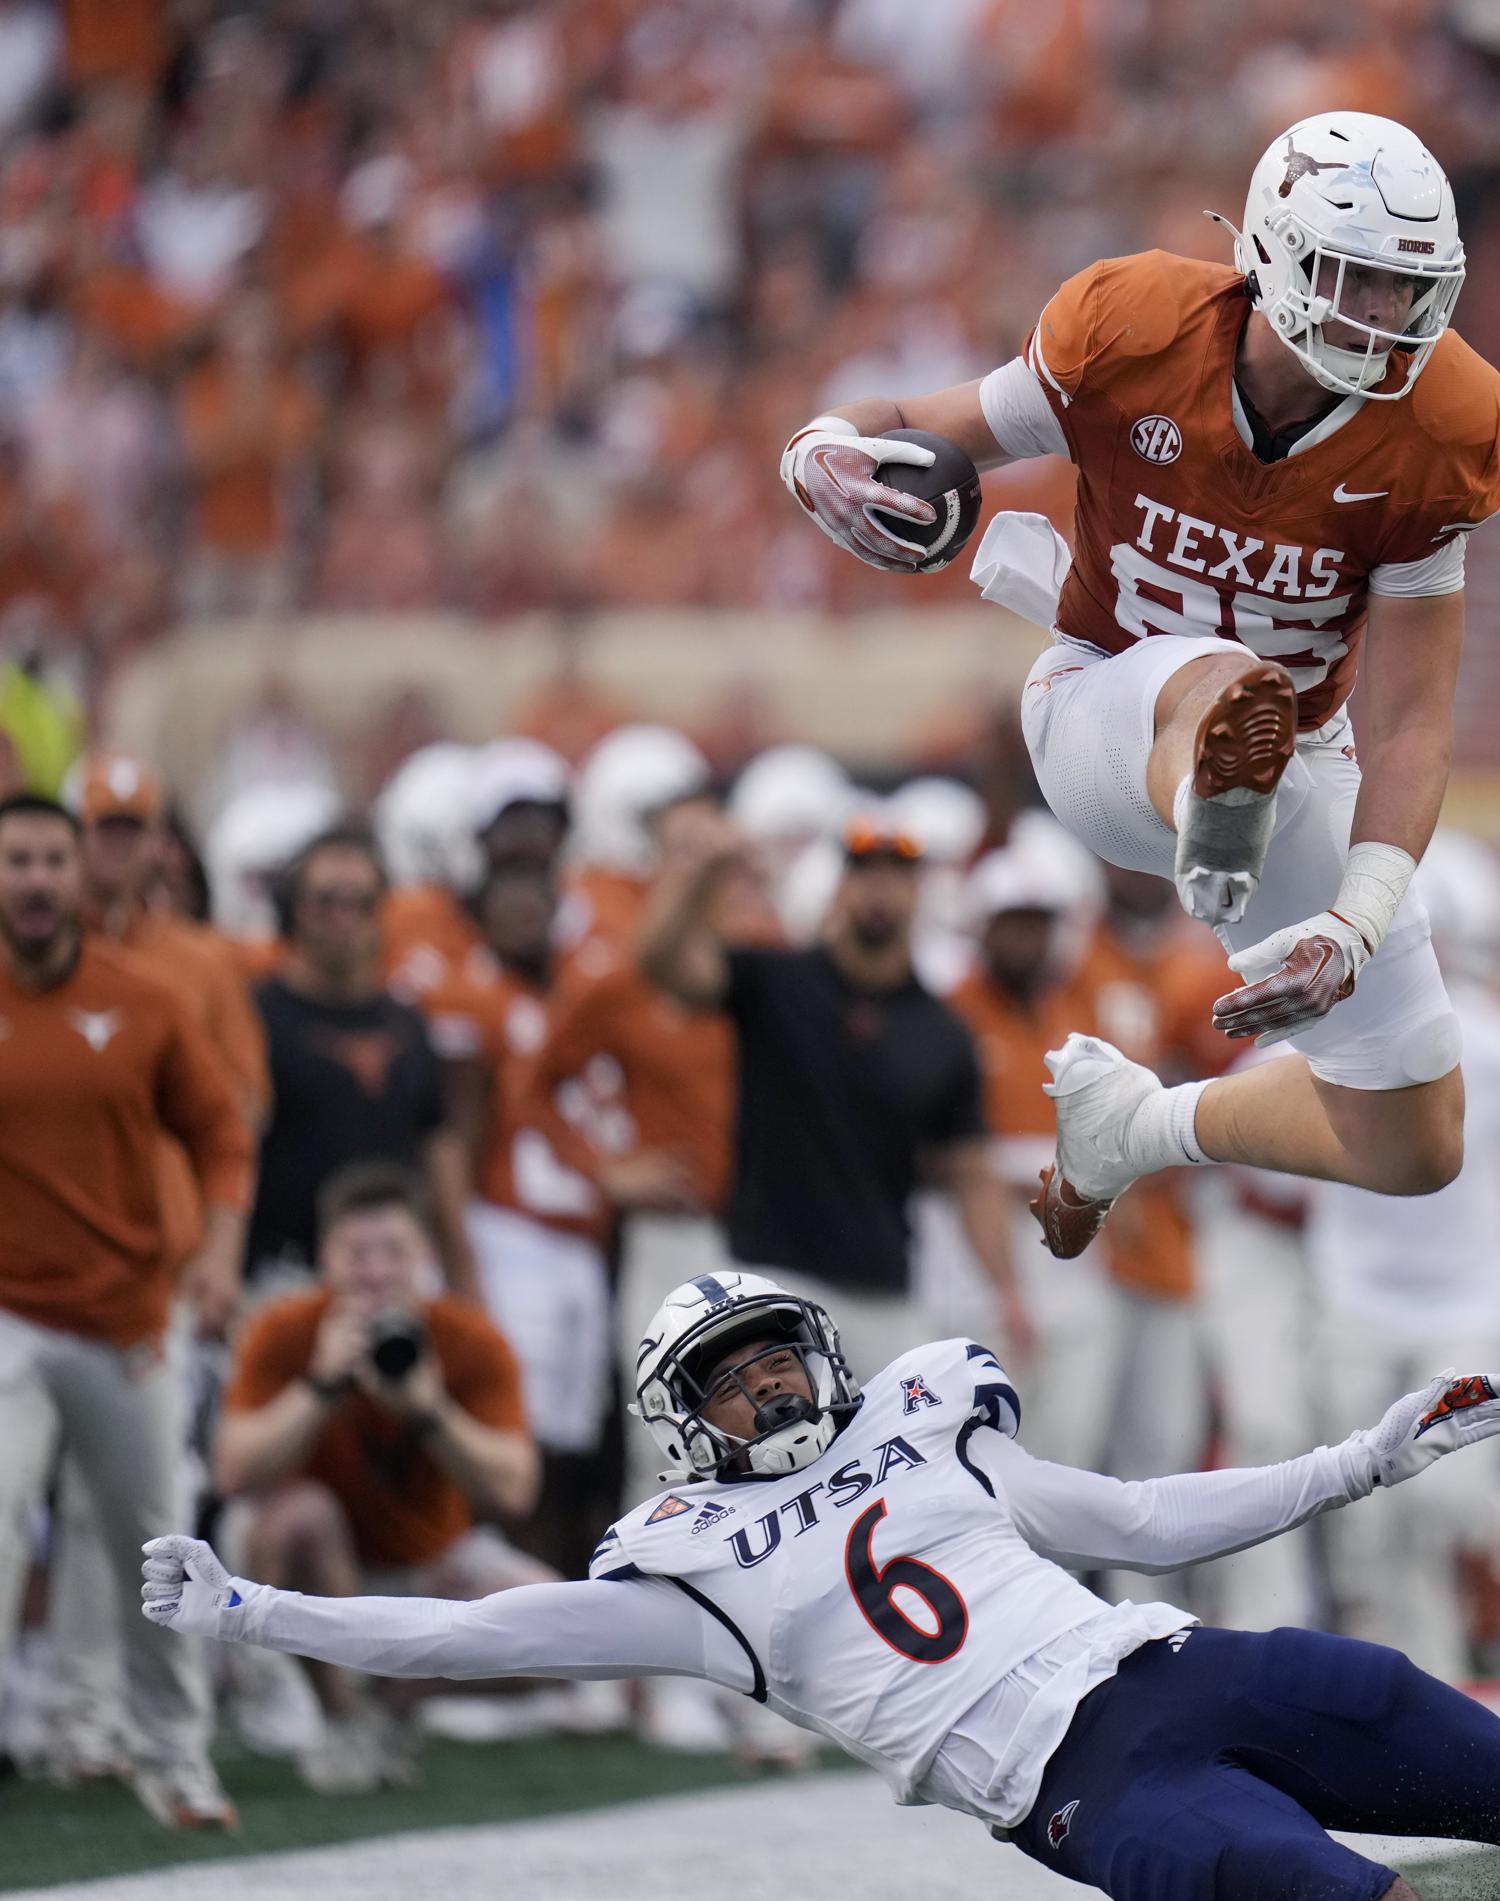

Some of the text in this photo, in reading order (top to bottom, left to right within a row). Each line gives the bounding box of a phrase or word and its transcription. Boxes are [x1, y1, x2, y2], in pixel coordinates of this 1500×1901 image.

[1397, 238, 1436, 255] HORNS
[1134, 419, 1179, 462] SEC
[1133, 492, 1346, 599] TEXAS
[1110, 542, 1353, 694] 85
[691, 1505, 737, 1535] adidas
[724, 1435, 929, 1569] UTSA
[844, 1497, 970, 1665] 6
